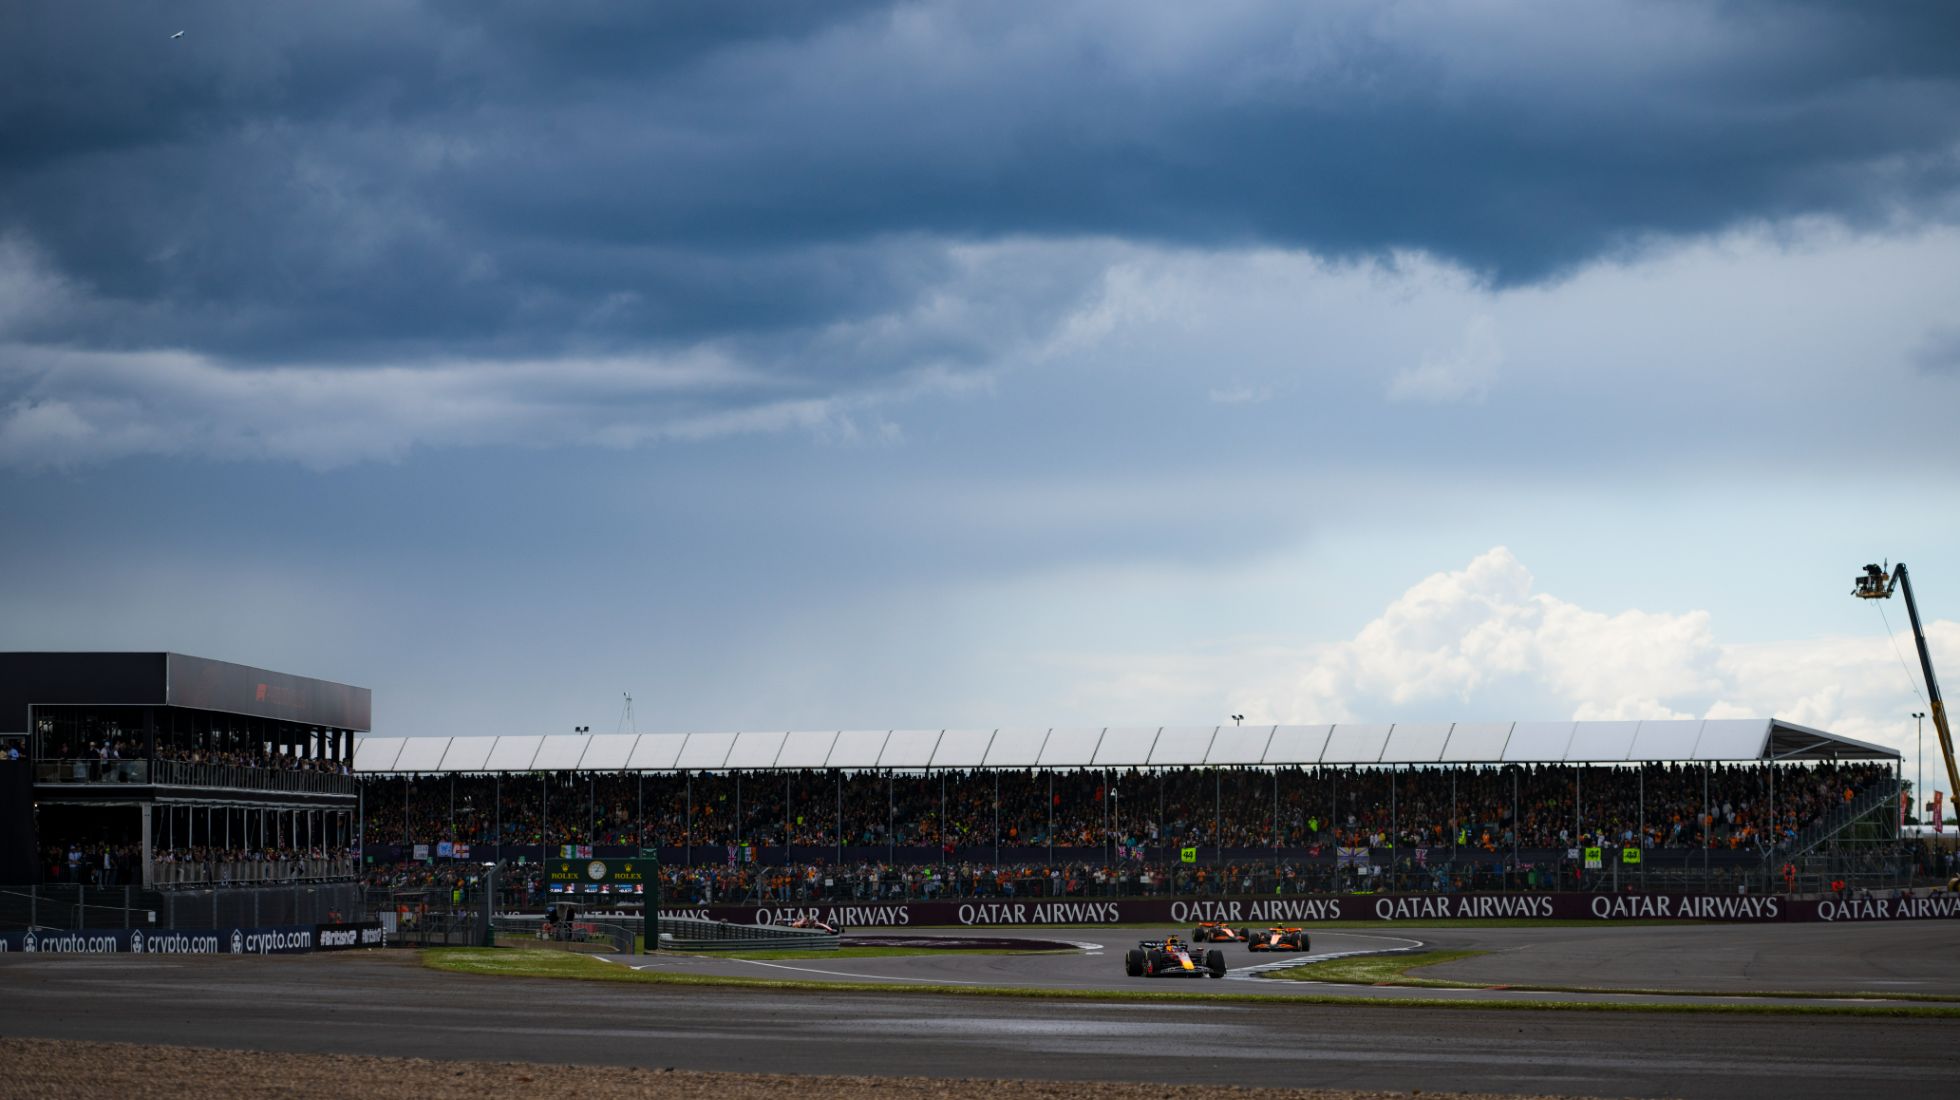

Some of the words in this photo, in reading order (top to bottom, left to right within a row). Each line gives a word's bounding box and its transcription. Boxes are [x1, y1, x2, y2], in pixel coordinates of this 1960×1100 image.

[1183, 851, 1193, 859] 44
[551, 872, 579, 880] ROLEX
[614, 872, 642, 880] ROLEX
[827, 905, 909, 926] AIRWAYS
[958, 904, 1027, 924] QATAR
[1033, 902, 1119, 923] AIRWAYS
[1170, 901, 1242, 923] QATAR
[1248, 899, 1341, 921] AIRWAYS
[1375, 898, 1450, 920] QATAR
[1457, 896, 1553, 918] AIRWAYS
[1591, 896, 1671, 919] QATAR
[1677, 896, 1778, 918] AIRWAYS
[1817, 900, 1889, 921] QATAR
[147, 933, 218, 953] crypto.com
[246, 929, 312, 955] crypto.com
